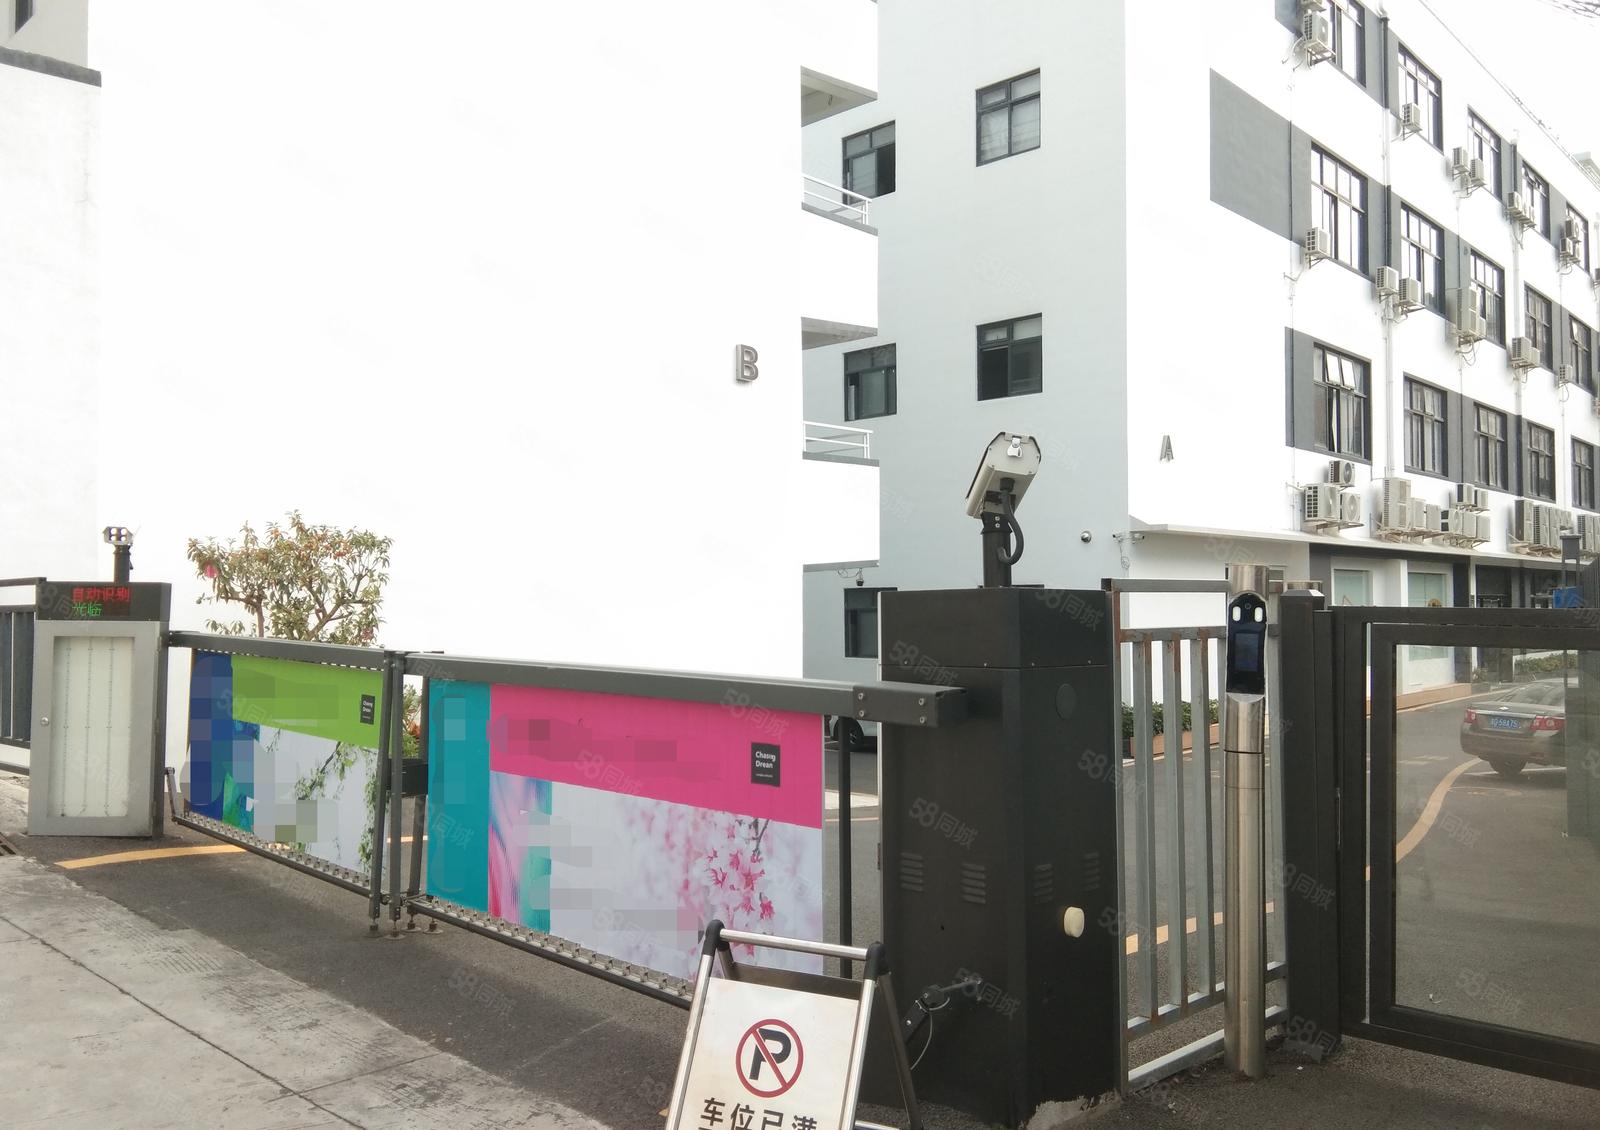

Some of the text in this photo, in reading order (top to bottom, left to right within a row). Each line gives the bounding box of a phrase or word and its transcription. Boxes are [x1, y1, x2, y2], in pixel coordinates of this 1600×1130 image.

[735, 344, 759, 382] B
[1160, 434, 1174, 462] A
[73, 586, 130, 602] 自动识别
[72, 602, 103, 617] 光临
